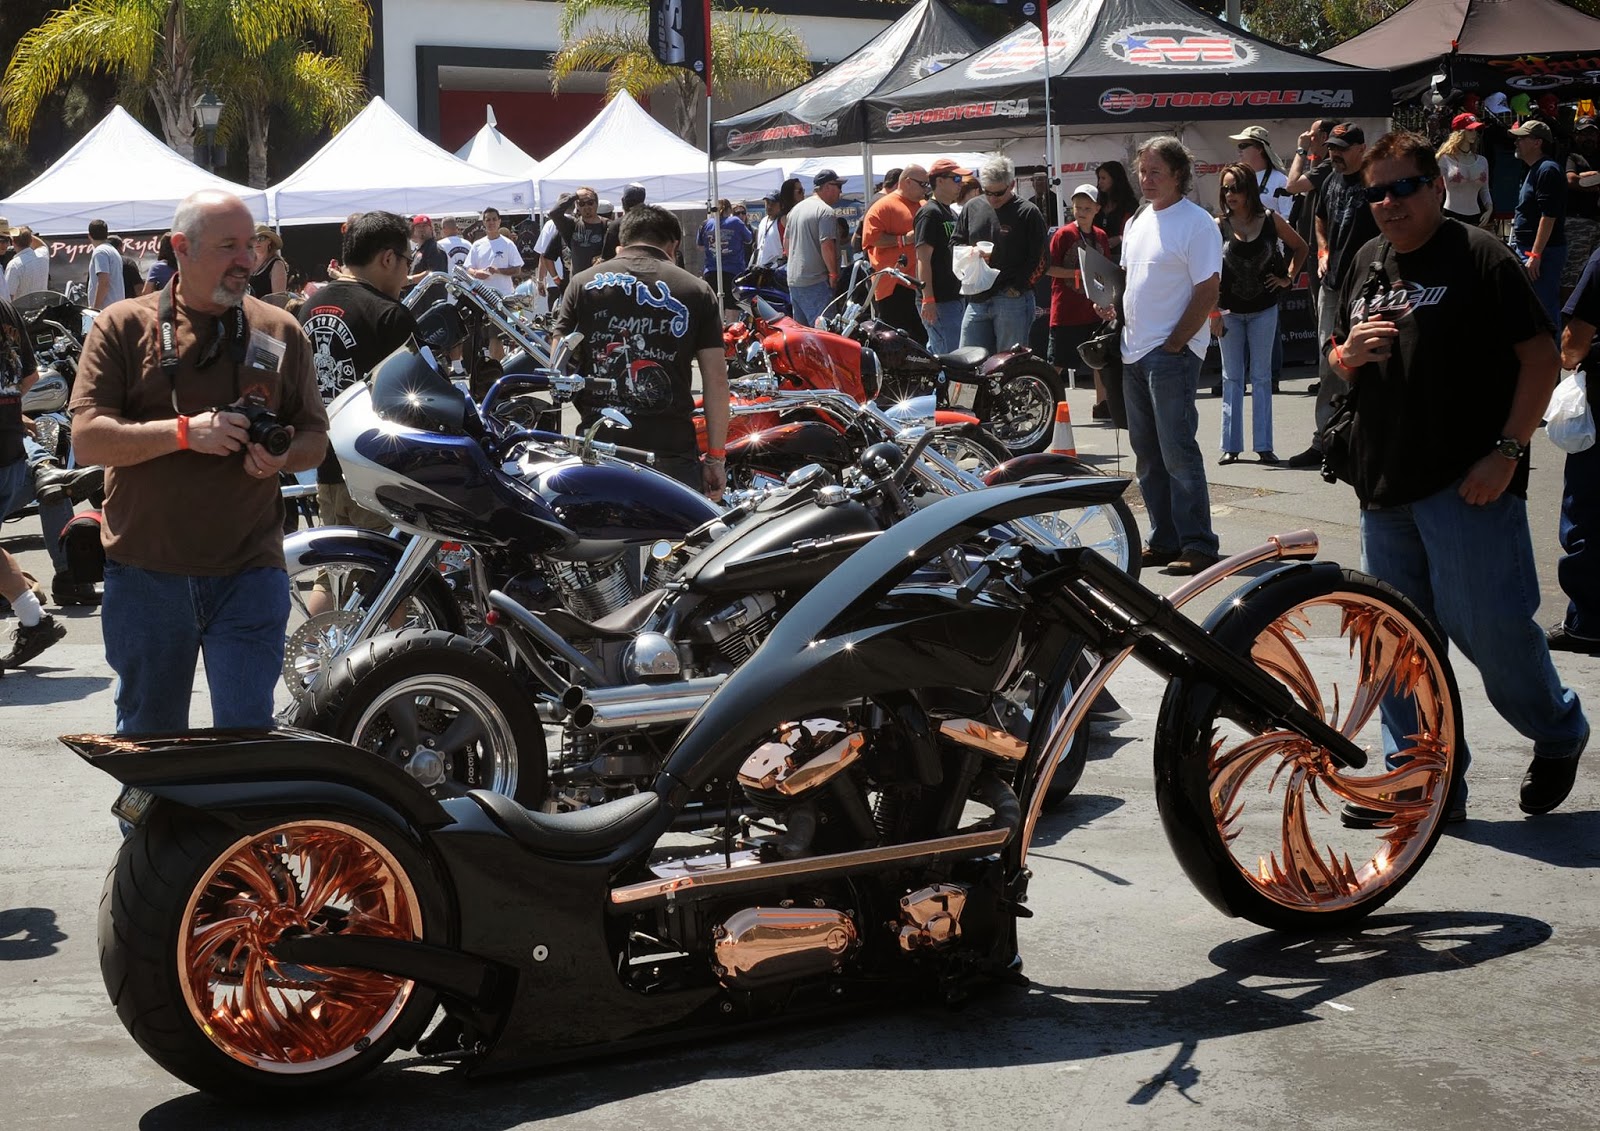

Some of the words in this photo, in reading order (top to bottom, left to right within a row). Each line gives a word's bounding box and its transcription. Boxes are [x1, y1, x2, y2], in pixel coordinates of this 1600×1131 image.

[316, 316, 327, 326] TO
[161, 321, 172, 351] Canon
[1289, 330, 1317, 340] Produc
